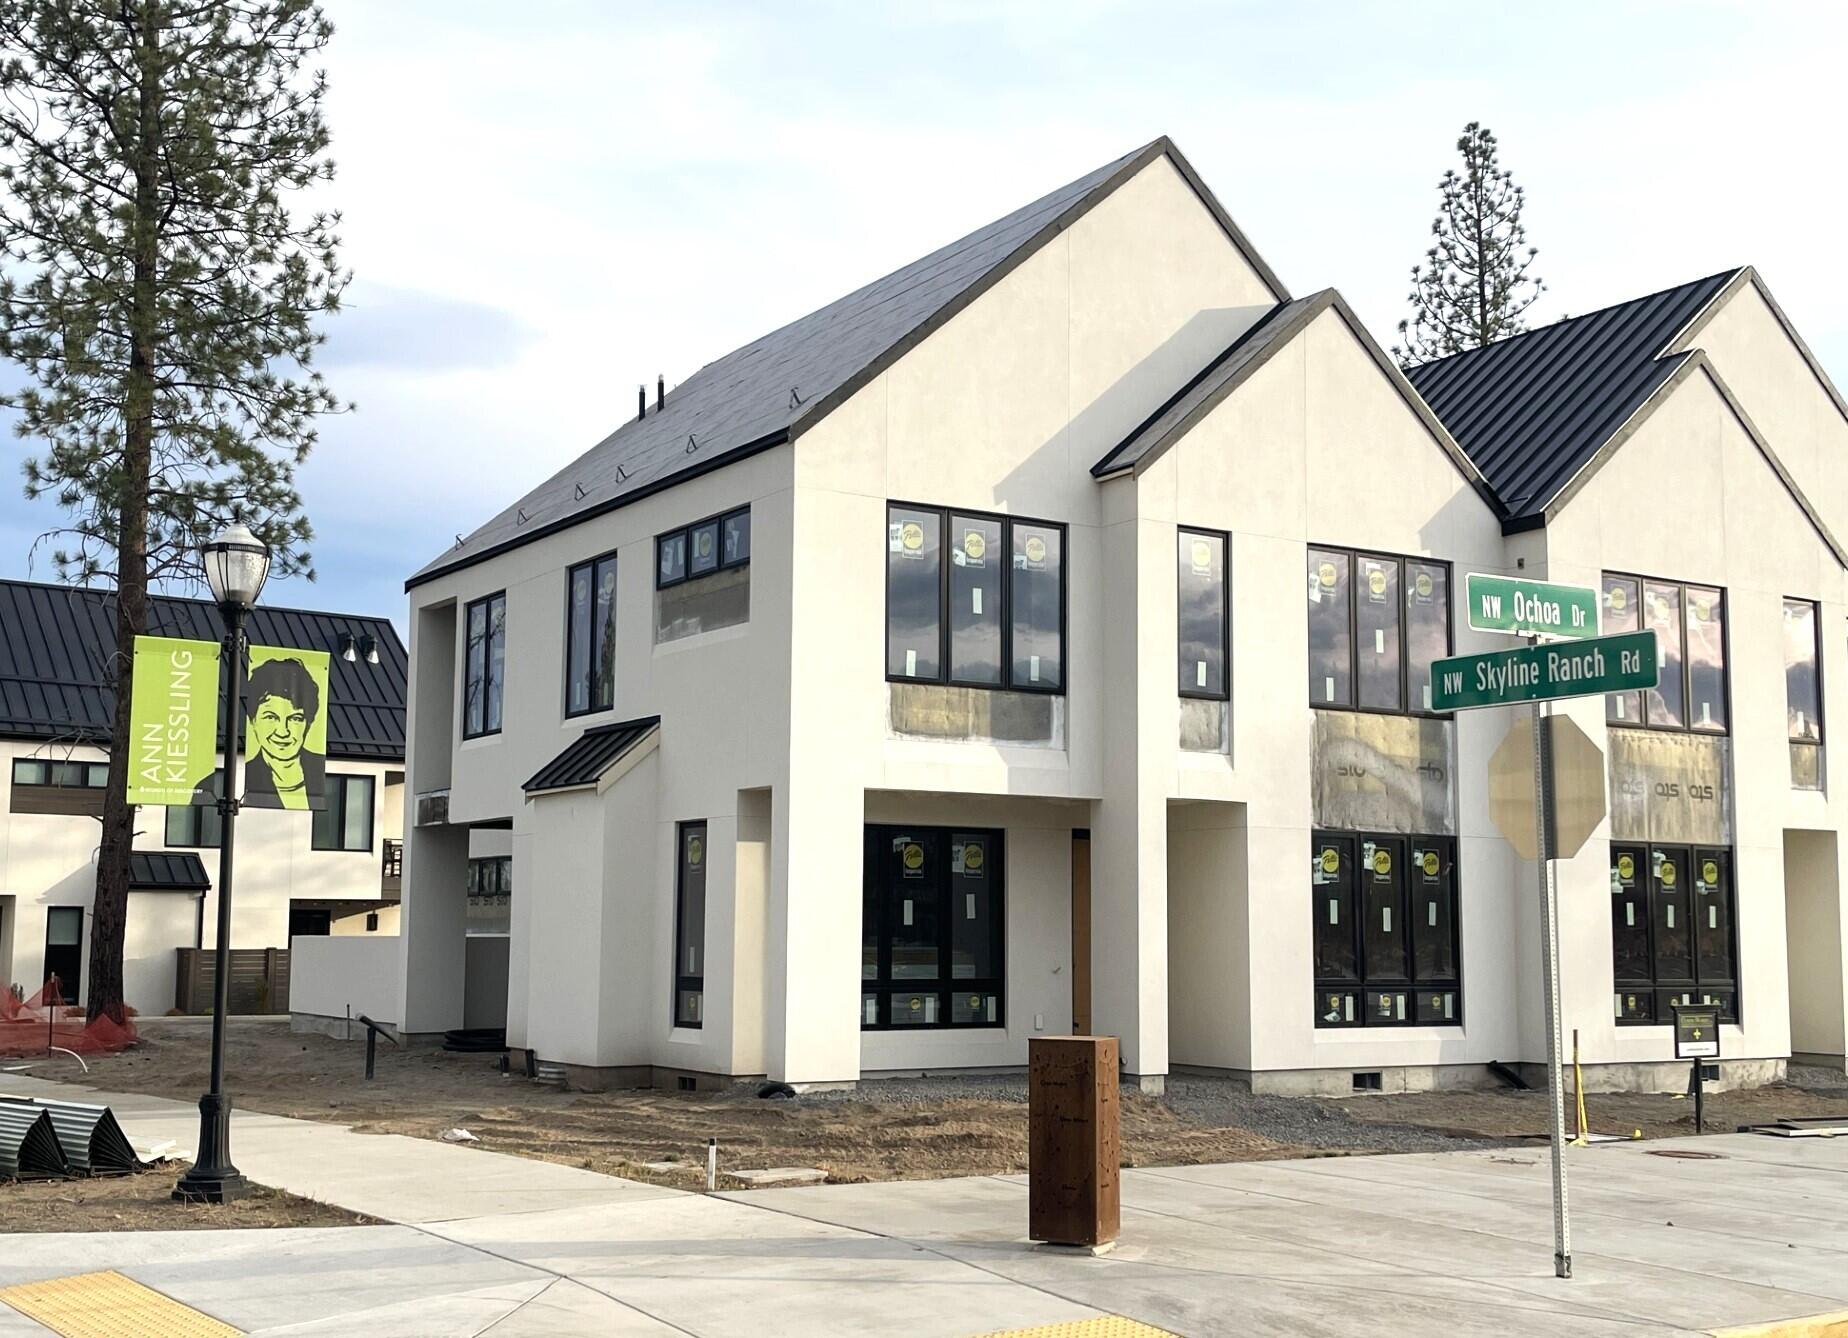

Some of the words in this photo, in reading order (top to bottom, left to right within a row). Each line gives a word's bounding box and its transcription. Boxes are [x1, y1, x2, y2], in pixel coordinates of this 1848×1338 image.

[1482, 594, 1501, 619] NW
[1513, 591, 1561, 626] Ochoa
[1572, 604, 1586, 628] Dr
[1443, 671, 1463, 695] NW
[1476, 656, 1540, 696] Skyline
[1548, 646, 1605, 683] Ranch
[1621, 649, 1640, 675] Rd
[165, 650, 193, 782] KIESSLING
[140, 723, 165, 784] ANN
